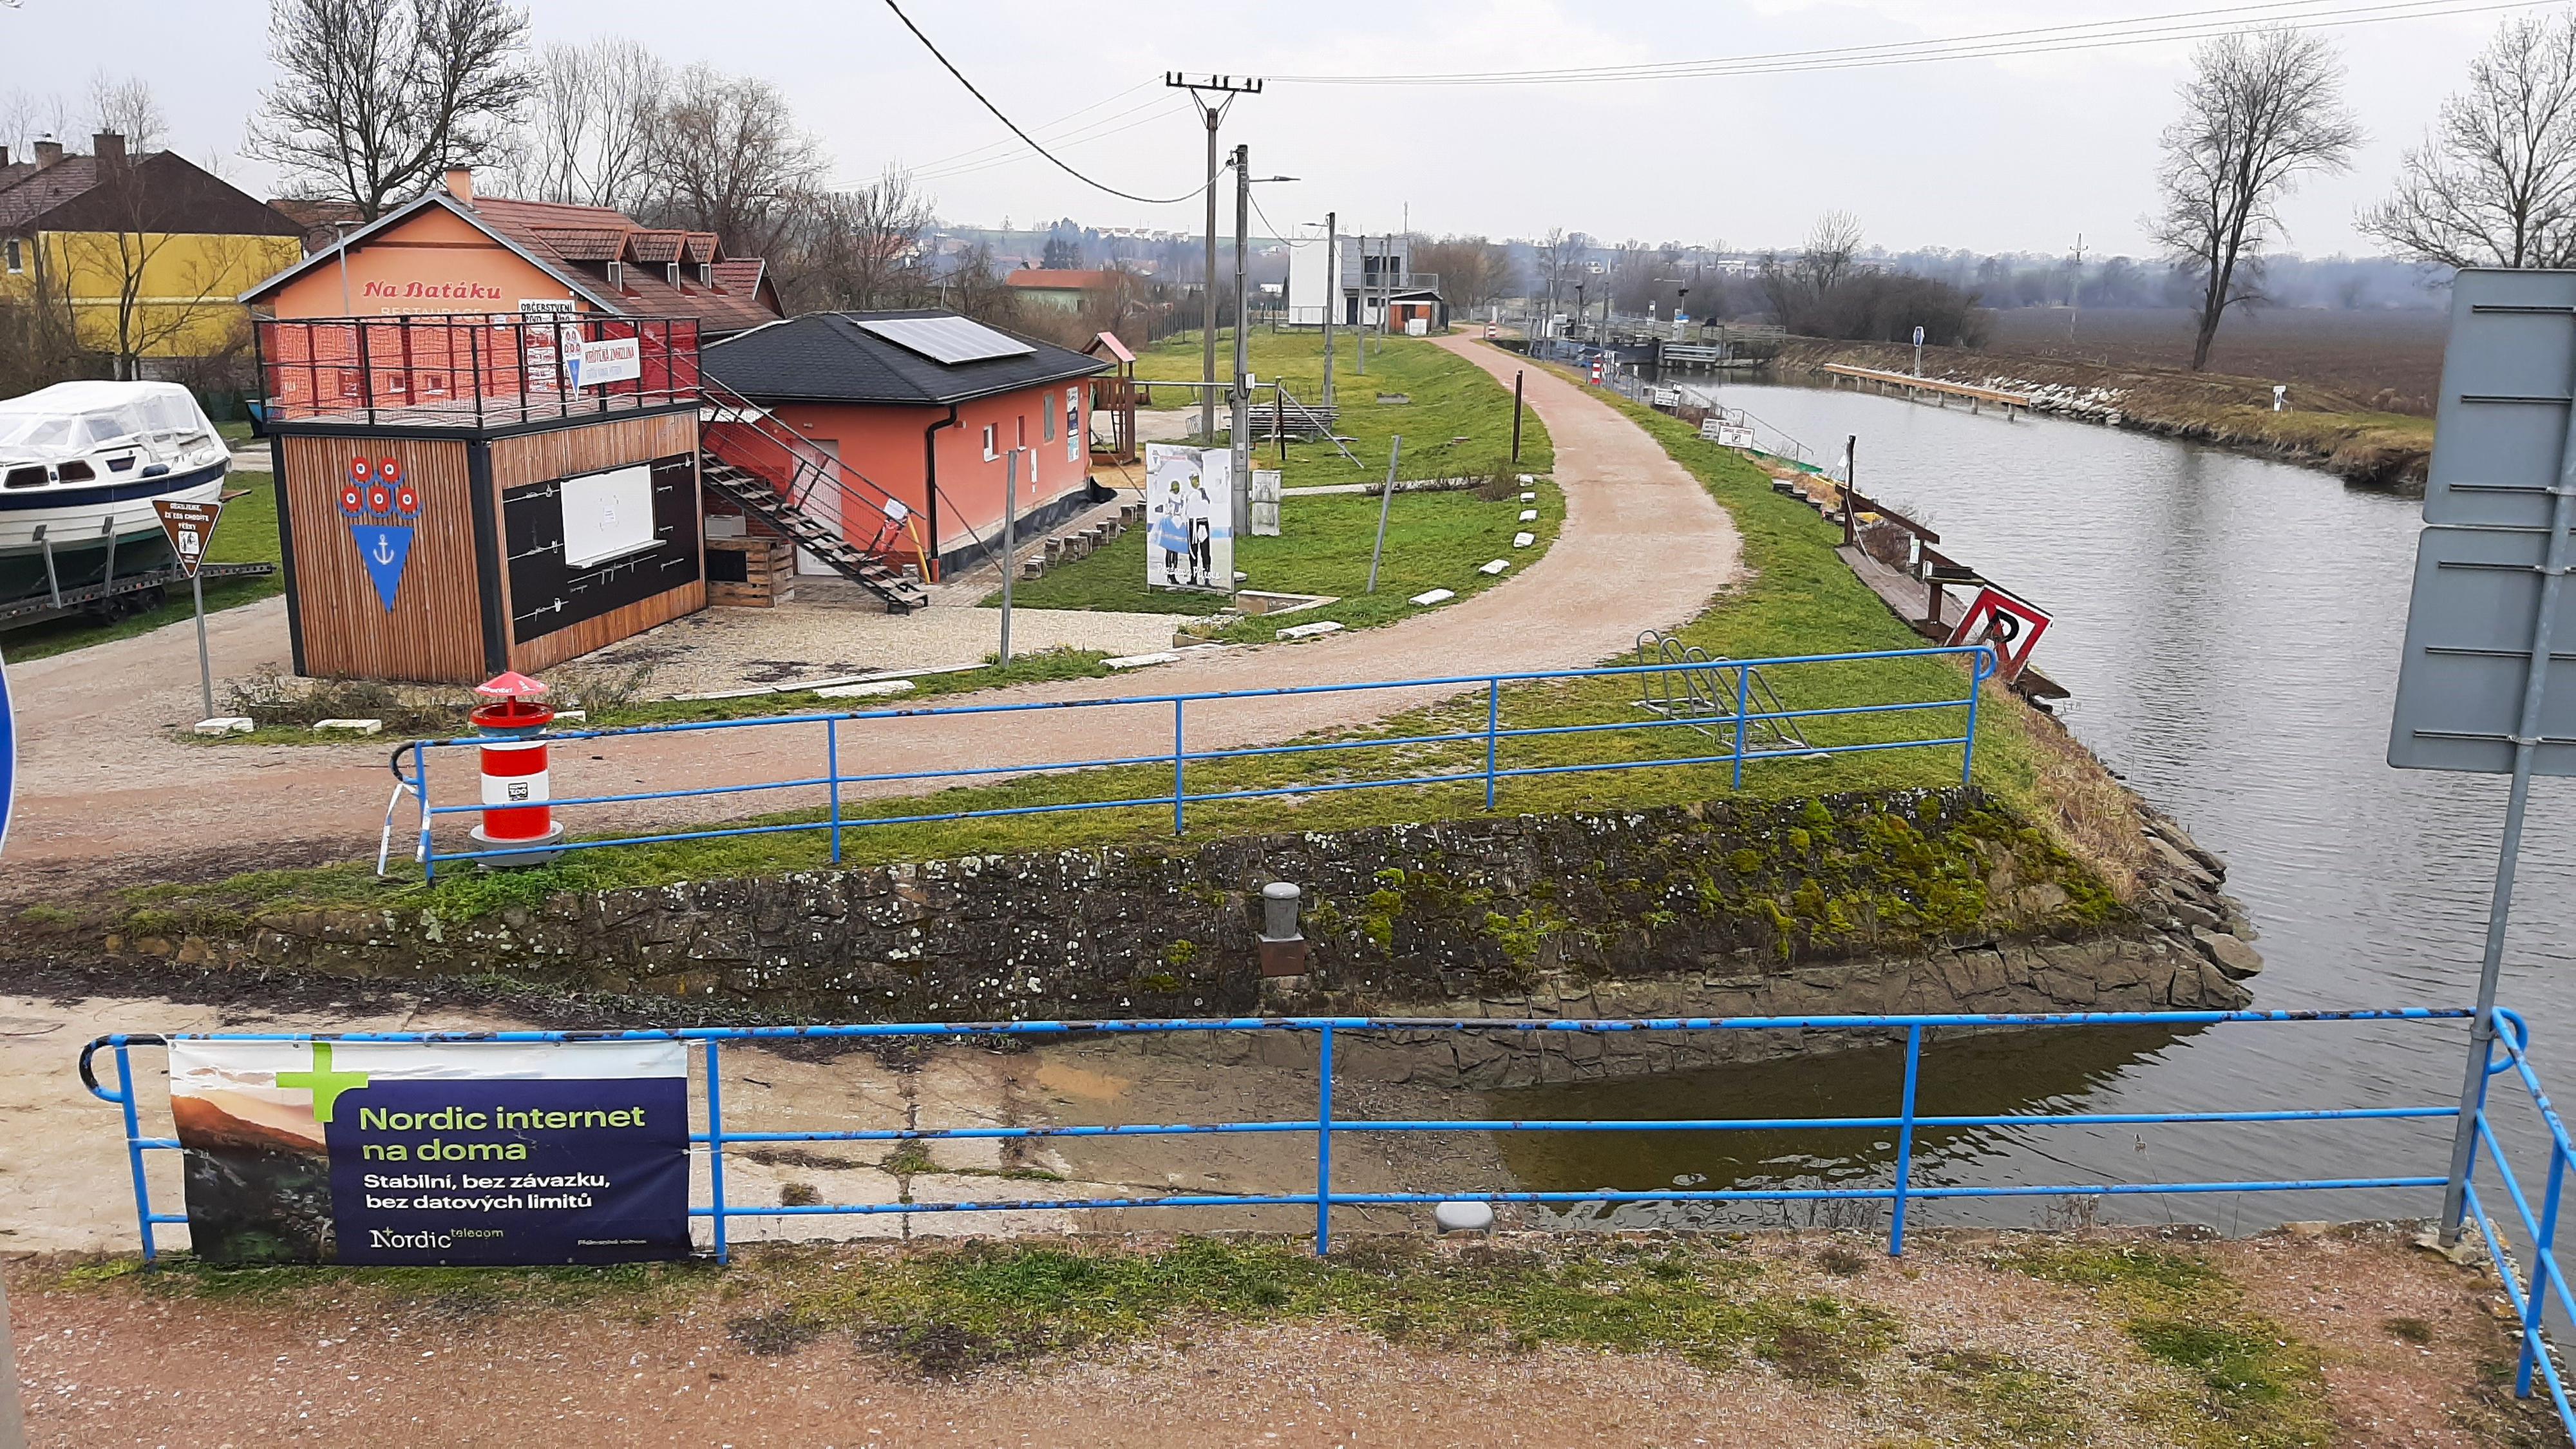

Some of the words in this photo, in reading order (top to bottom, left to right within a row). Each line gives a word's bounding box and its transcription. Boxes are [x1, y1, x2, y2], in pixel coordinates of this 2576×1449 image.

[363, 281, 398, 298] Na
[403, 281, 501, 299] Baťáku
[359, 1106, 488, 1130] Nordic
[496, 1106, 646, 1130] internet
[363, 1143, 408, 1160] na
[417, 1138, 527, 1160] doma
[364, 1174, 457, 1190] Stabilní,
[463, 1173, 505, 1189] bez
[510, 1173, 611, 1188] závazku,
[366, 1195, 408, 1209] bez
[413, 1195, 522, 1211] datových
[527, 1193, 592, 1209] limitů
[369, 1229, 451, 1249] Nordic
[451, 1227, 504, 1238] telecom
